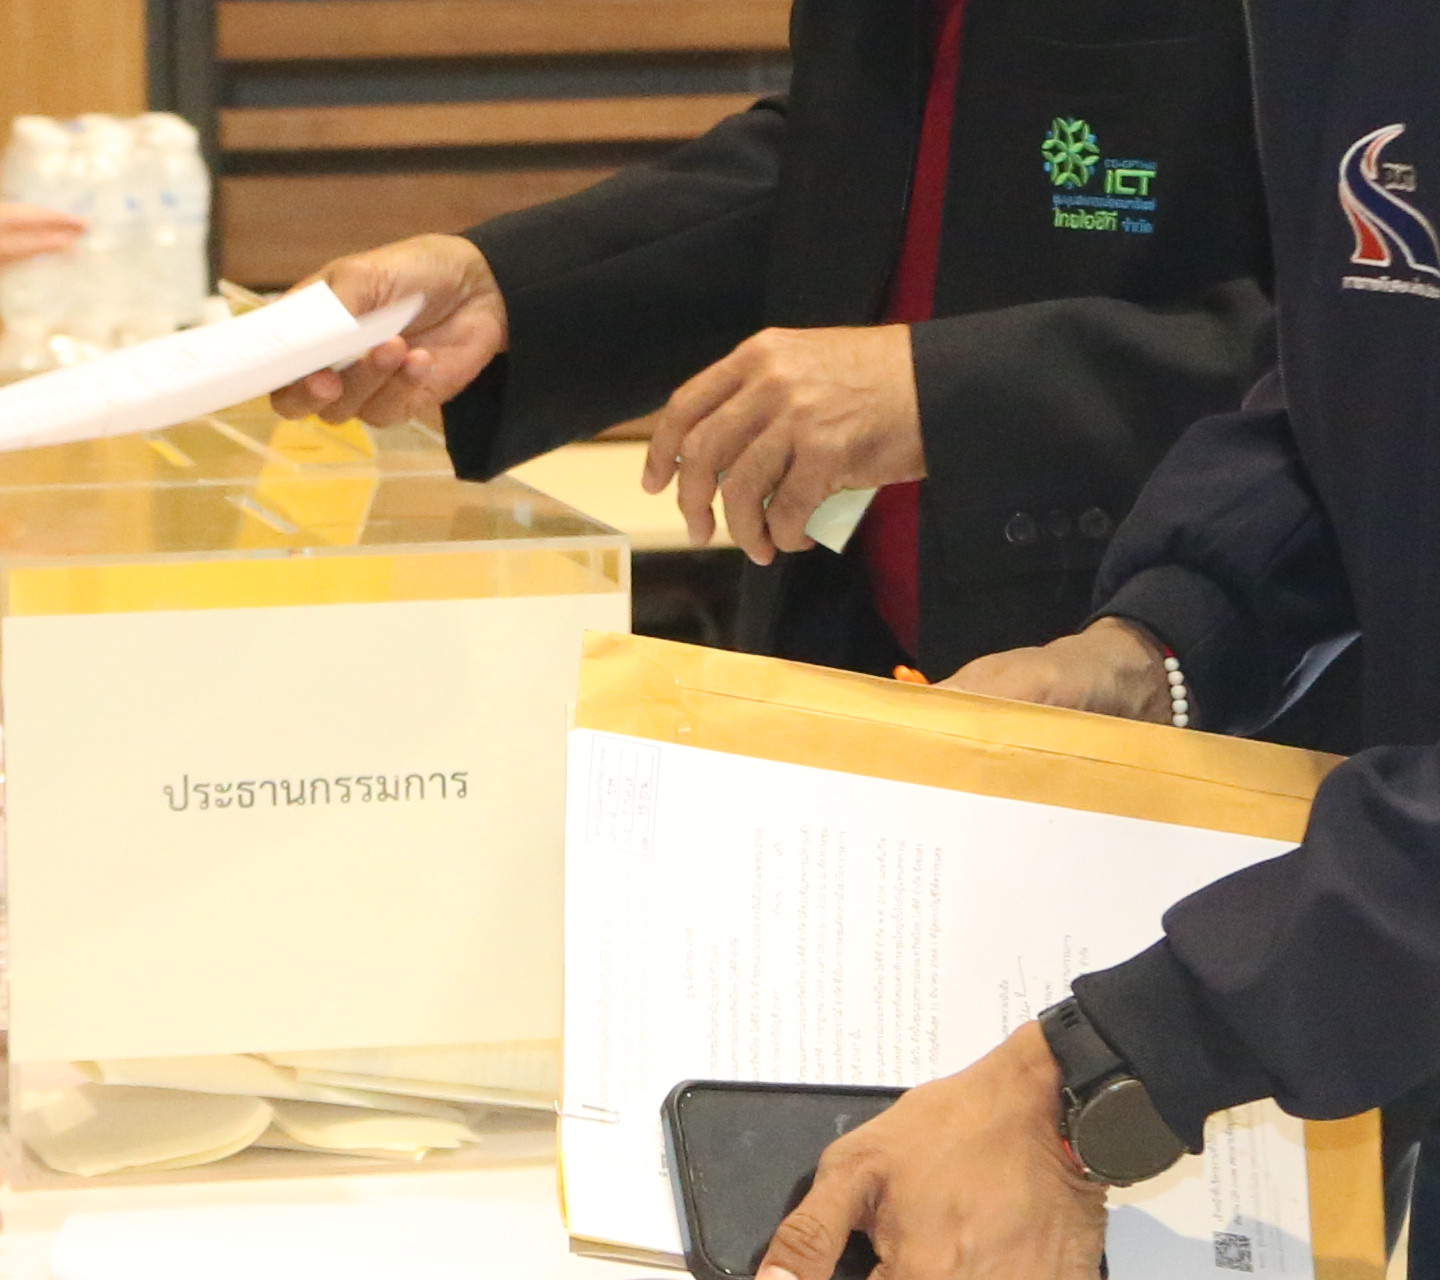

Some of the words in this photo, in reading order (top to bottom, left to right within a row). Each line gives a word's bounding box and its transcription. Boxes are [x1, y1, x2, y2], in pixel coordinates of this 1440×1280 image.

[1105, 169, 1156, 195] ICT
[162, 770, 470, 812] ประธานกรรมการ
